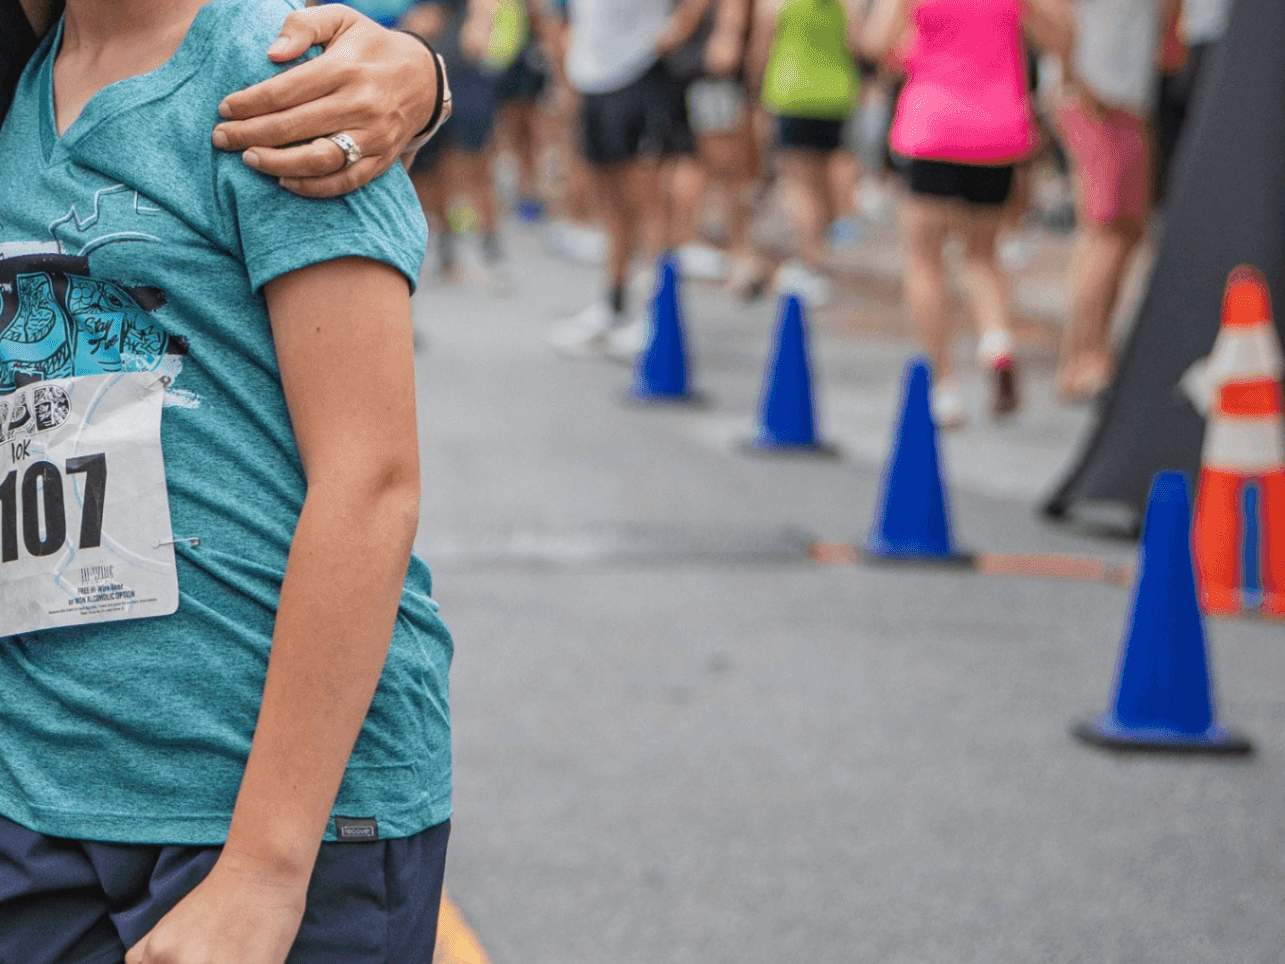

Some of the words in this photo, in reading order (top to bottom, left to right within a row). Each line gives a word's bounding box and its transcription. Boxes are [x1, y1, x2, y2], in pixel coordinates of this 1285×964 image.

[10, 439, 31, 464] 10K
[77, 586, 90, 595] FREE
[75, 596, 86, 604] NON
